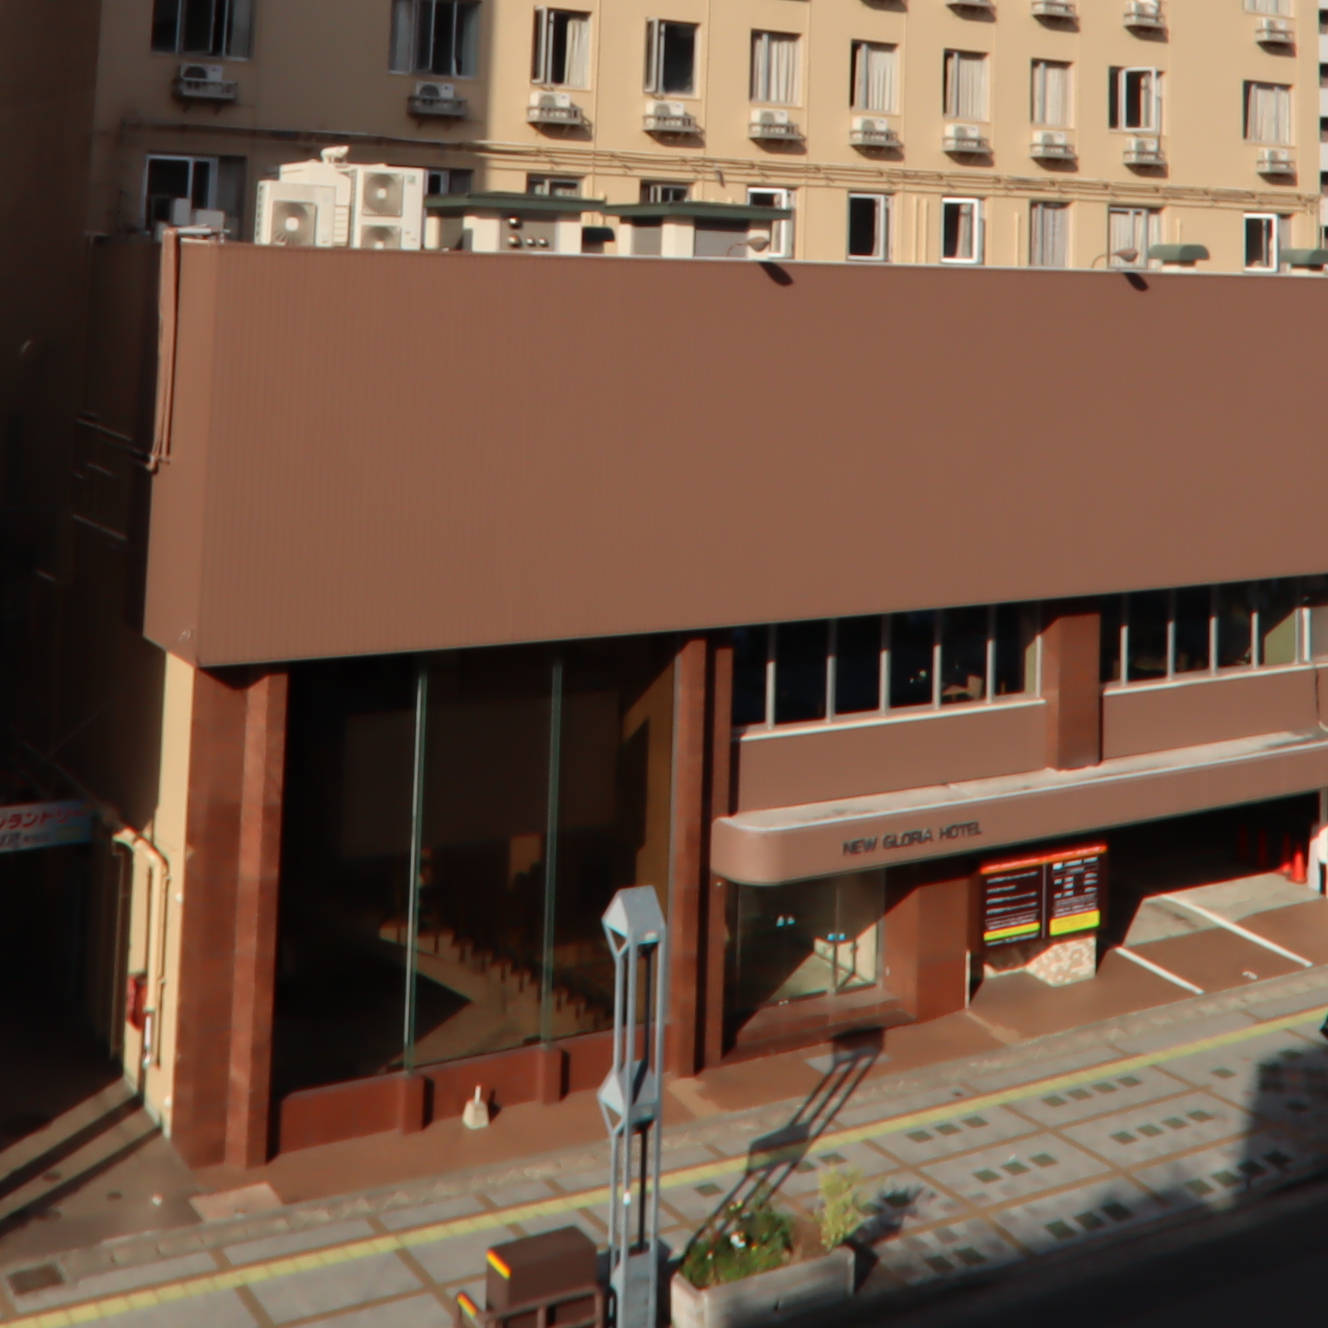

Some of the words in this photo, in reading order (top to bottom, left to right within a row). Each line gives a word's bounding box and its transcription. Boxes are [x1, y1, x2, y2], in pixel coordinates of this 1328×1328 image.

[842, 836, 878, 855] NEW
[882, 827, 934, 850] GLORIA
[939, 820, 983, 840] HOTEL
